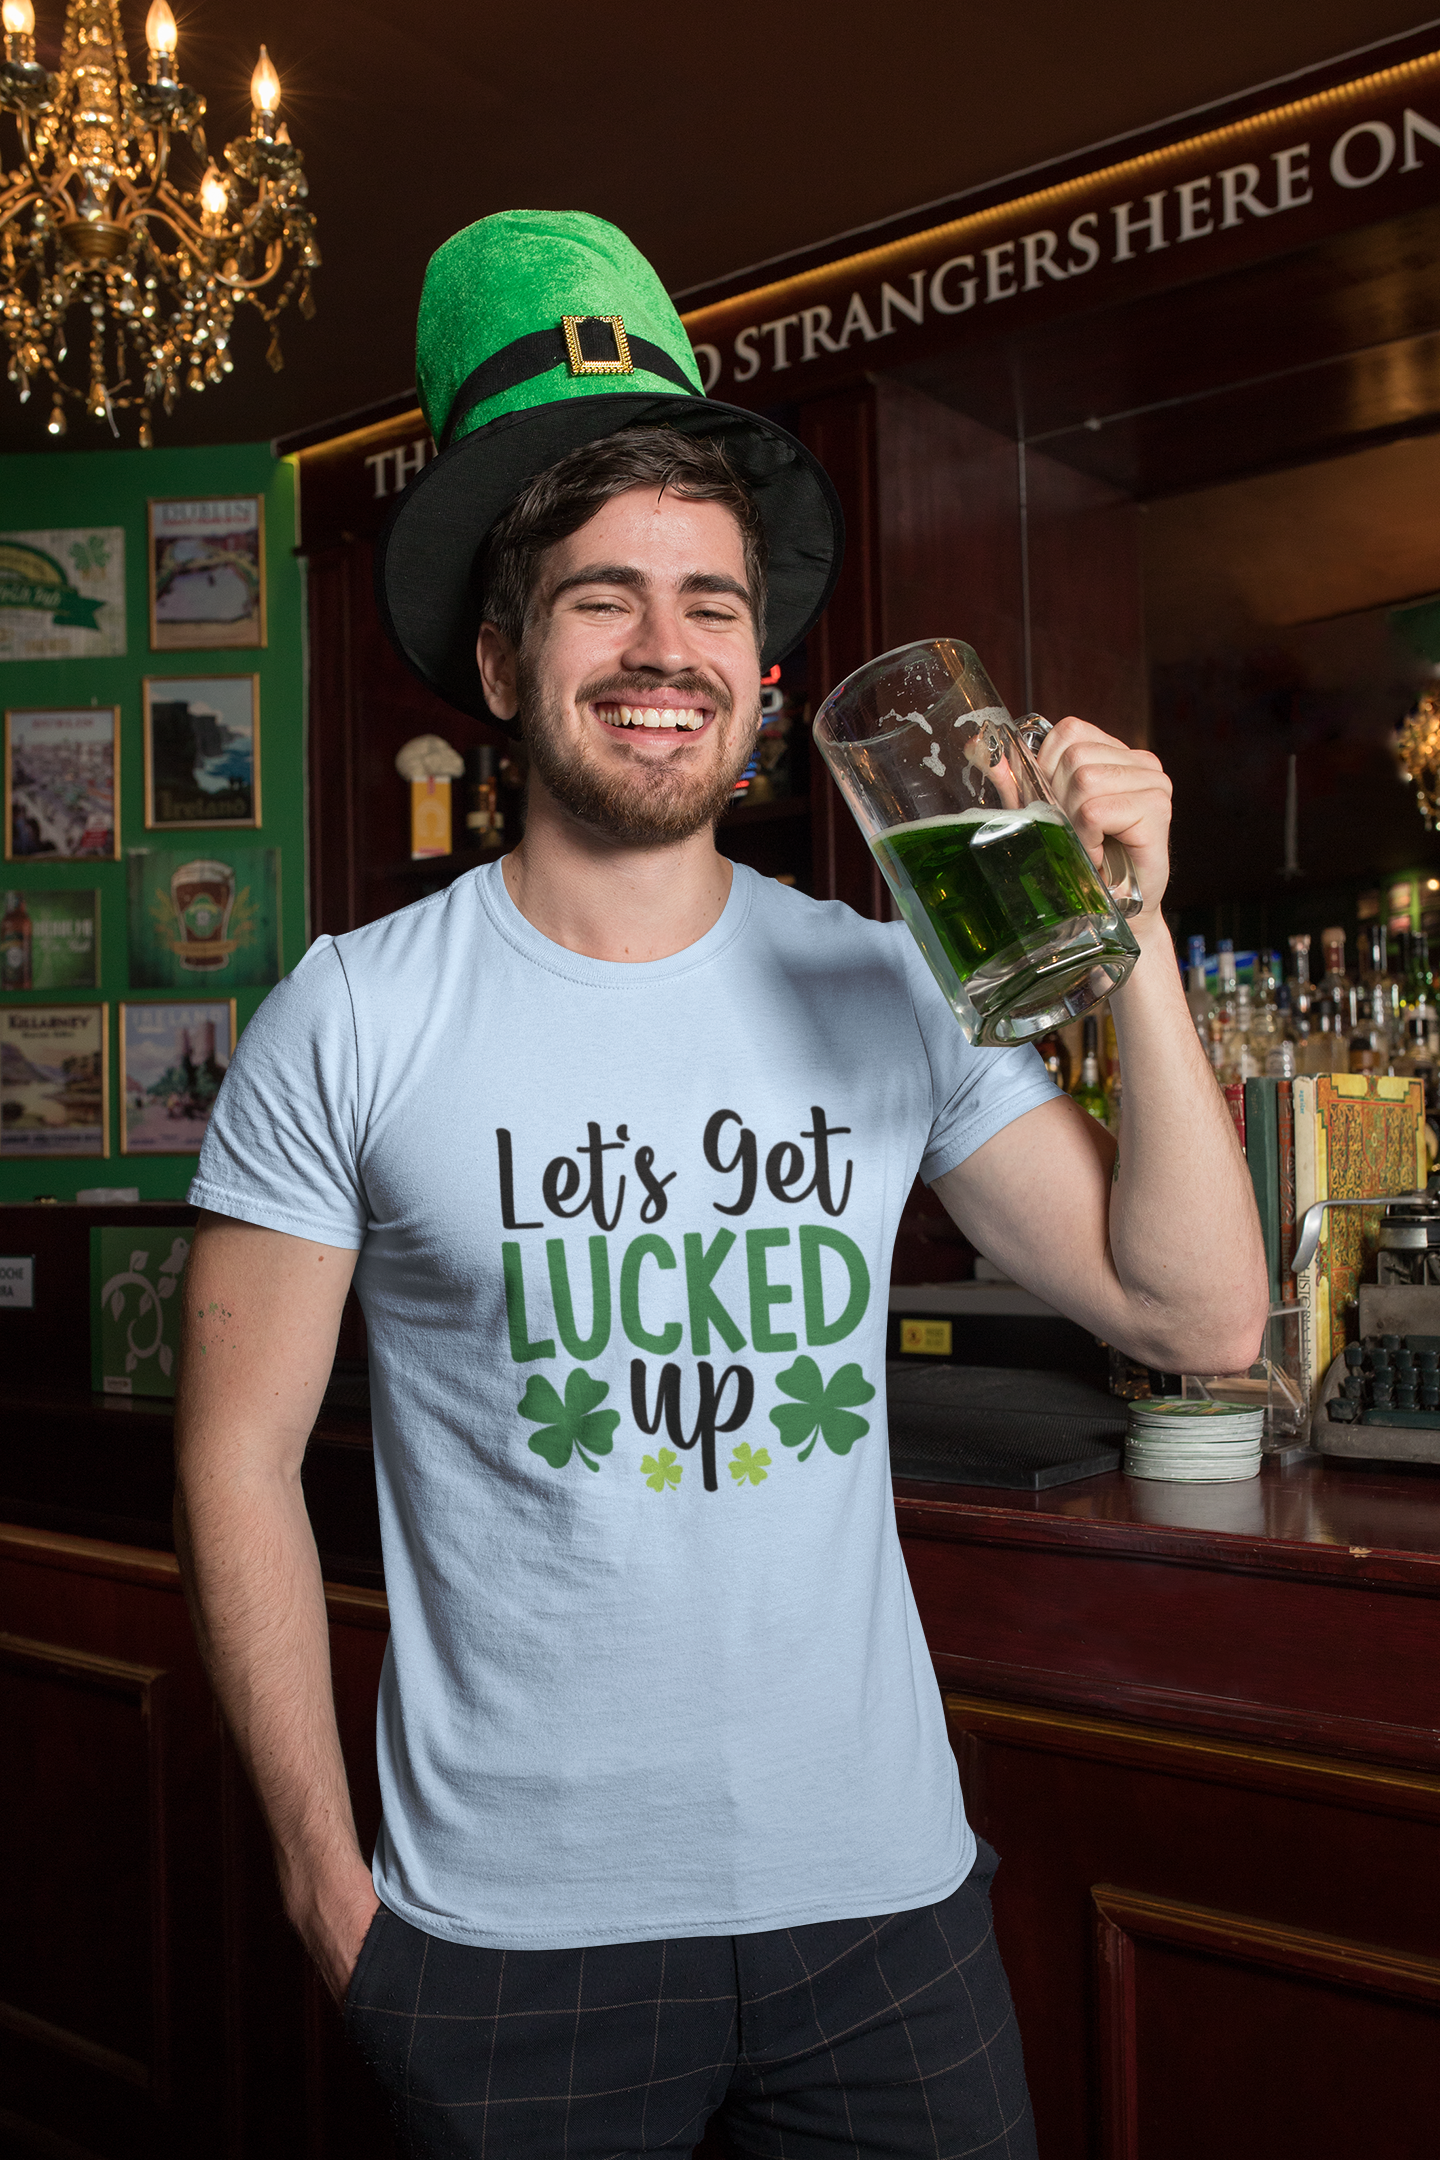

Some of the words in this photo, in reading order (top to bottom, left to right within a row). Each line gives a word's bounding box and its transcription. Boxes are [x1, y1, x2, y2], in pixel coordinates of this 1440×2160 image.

[363, 435, 438, 499] TH
[733, 213, 1101, 382] STRANGERS
[1110, 143, 1314, 263] HERE
[496, 1121, 677, 1231] Let's
[502, 1224, 871, 1363] LUCKED
